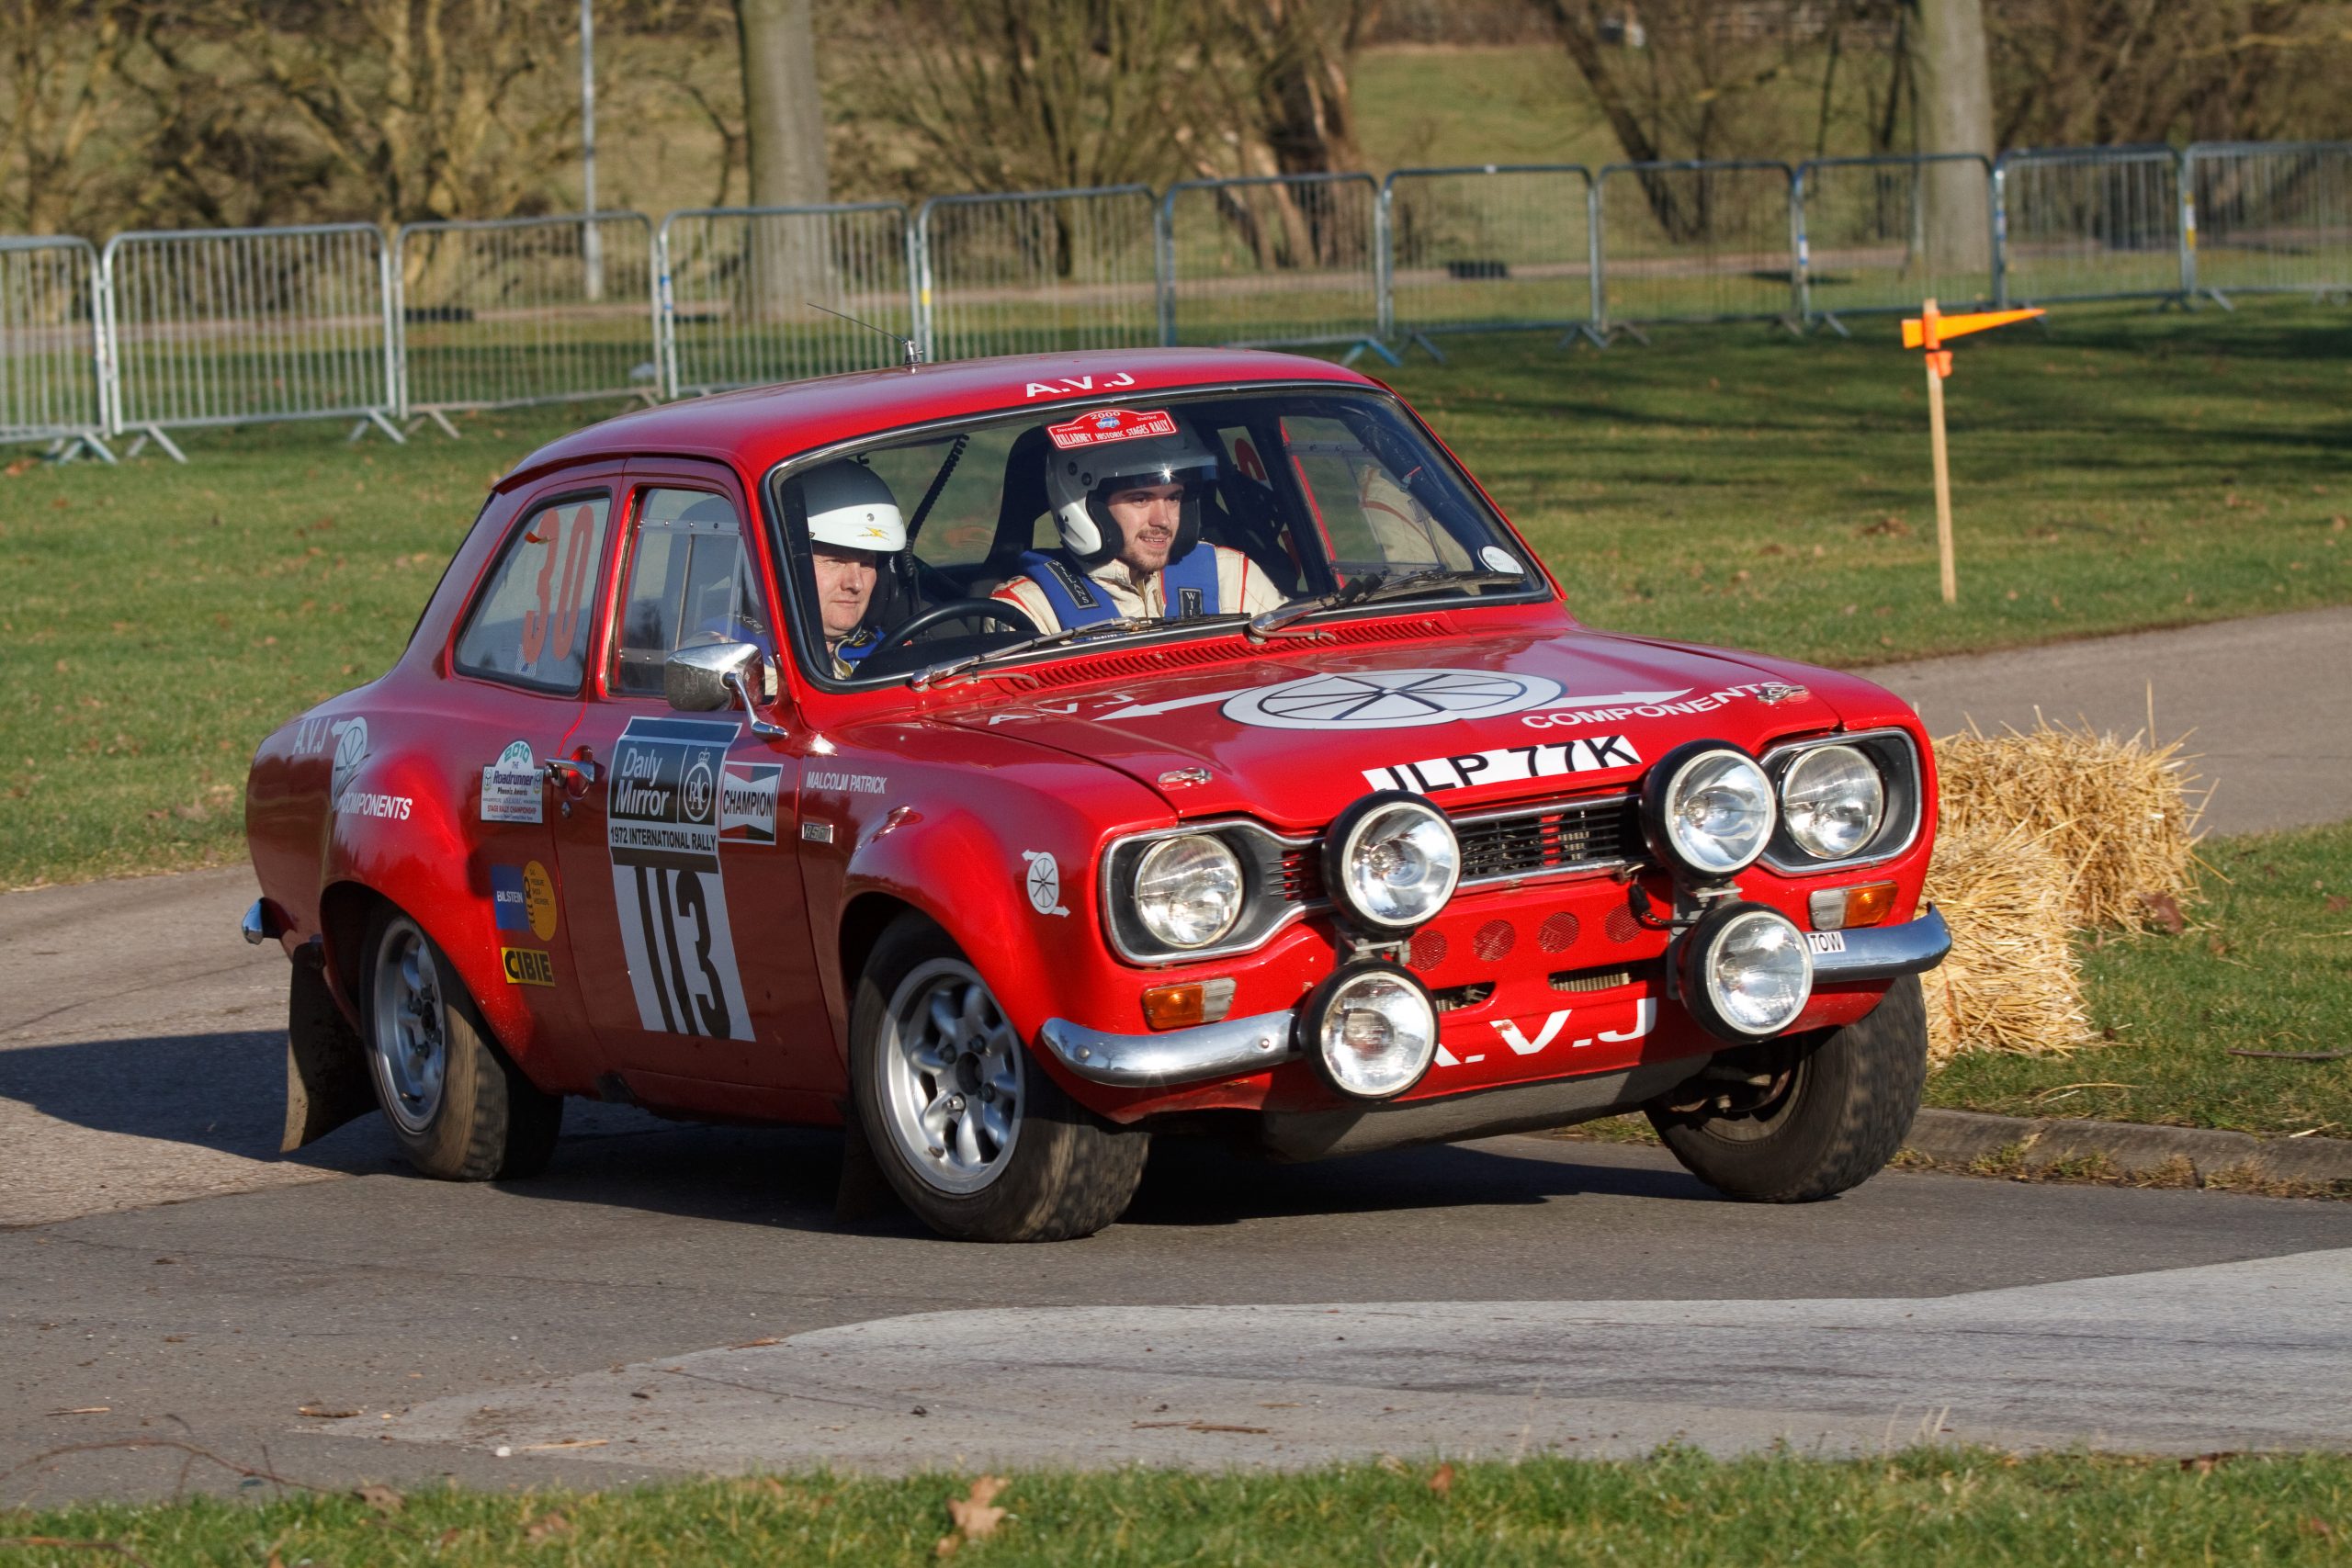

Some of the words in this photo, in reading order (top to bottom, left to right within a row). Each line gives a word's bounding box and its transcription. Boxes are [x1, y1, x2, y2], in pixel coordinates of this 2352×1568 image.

[1026, 372, 1136, 398] A.V.J
[1090, 411, 1121, 421] 2000
[1055, 434, 1092, 446] KILLARNEY
[1096, 430, 1124, 441] HISTORIC
[1127, 424, 1149, 436] STAGES
[1148, 419, 1170, 433] RALLY
[521, 504, 594, 663] 30
[1052, 560, 1090, 604] WILLANS
[1521, 681, 1790, 729] COMPONENTS
[292, 717, 332, 755] A.V.J
[503, 742, 530, 763] 2010
[621, 747, 663, 787] Daily
[1507, 735, 1640, 777] 77K
[492, 770, 533, 786] Roadrunner
[689, 772, 709, 811] RAC
[806, 770, 849, 791] MALCOLM
[849, 773, 888, 795] PATRICK
[341, 792, 413, 820] COMPONENTS
[615, 779, 671, 817] Mirror
[722, 789, 774, 818] CHAMPION
[610, 826, 628, 844] 1972
[628, 827, 691, 849] INTERNATIONAL
[691, 832, 717, 852] RALLY
[496, 890, 524, 904] BILSTEIN
[634, 866, 731, 1041] 113
[1809, 932, 1841, 953] TOW
[504, 950, 553, 984] CIBIE
